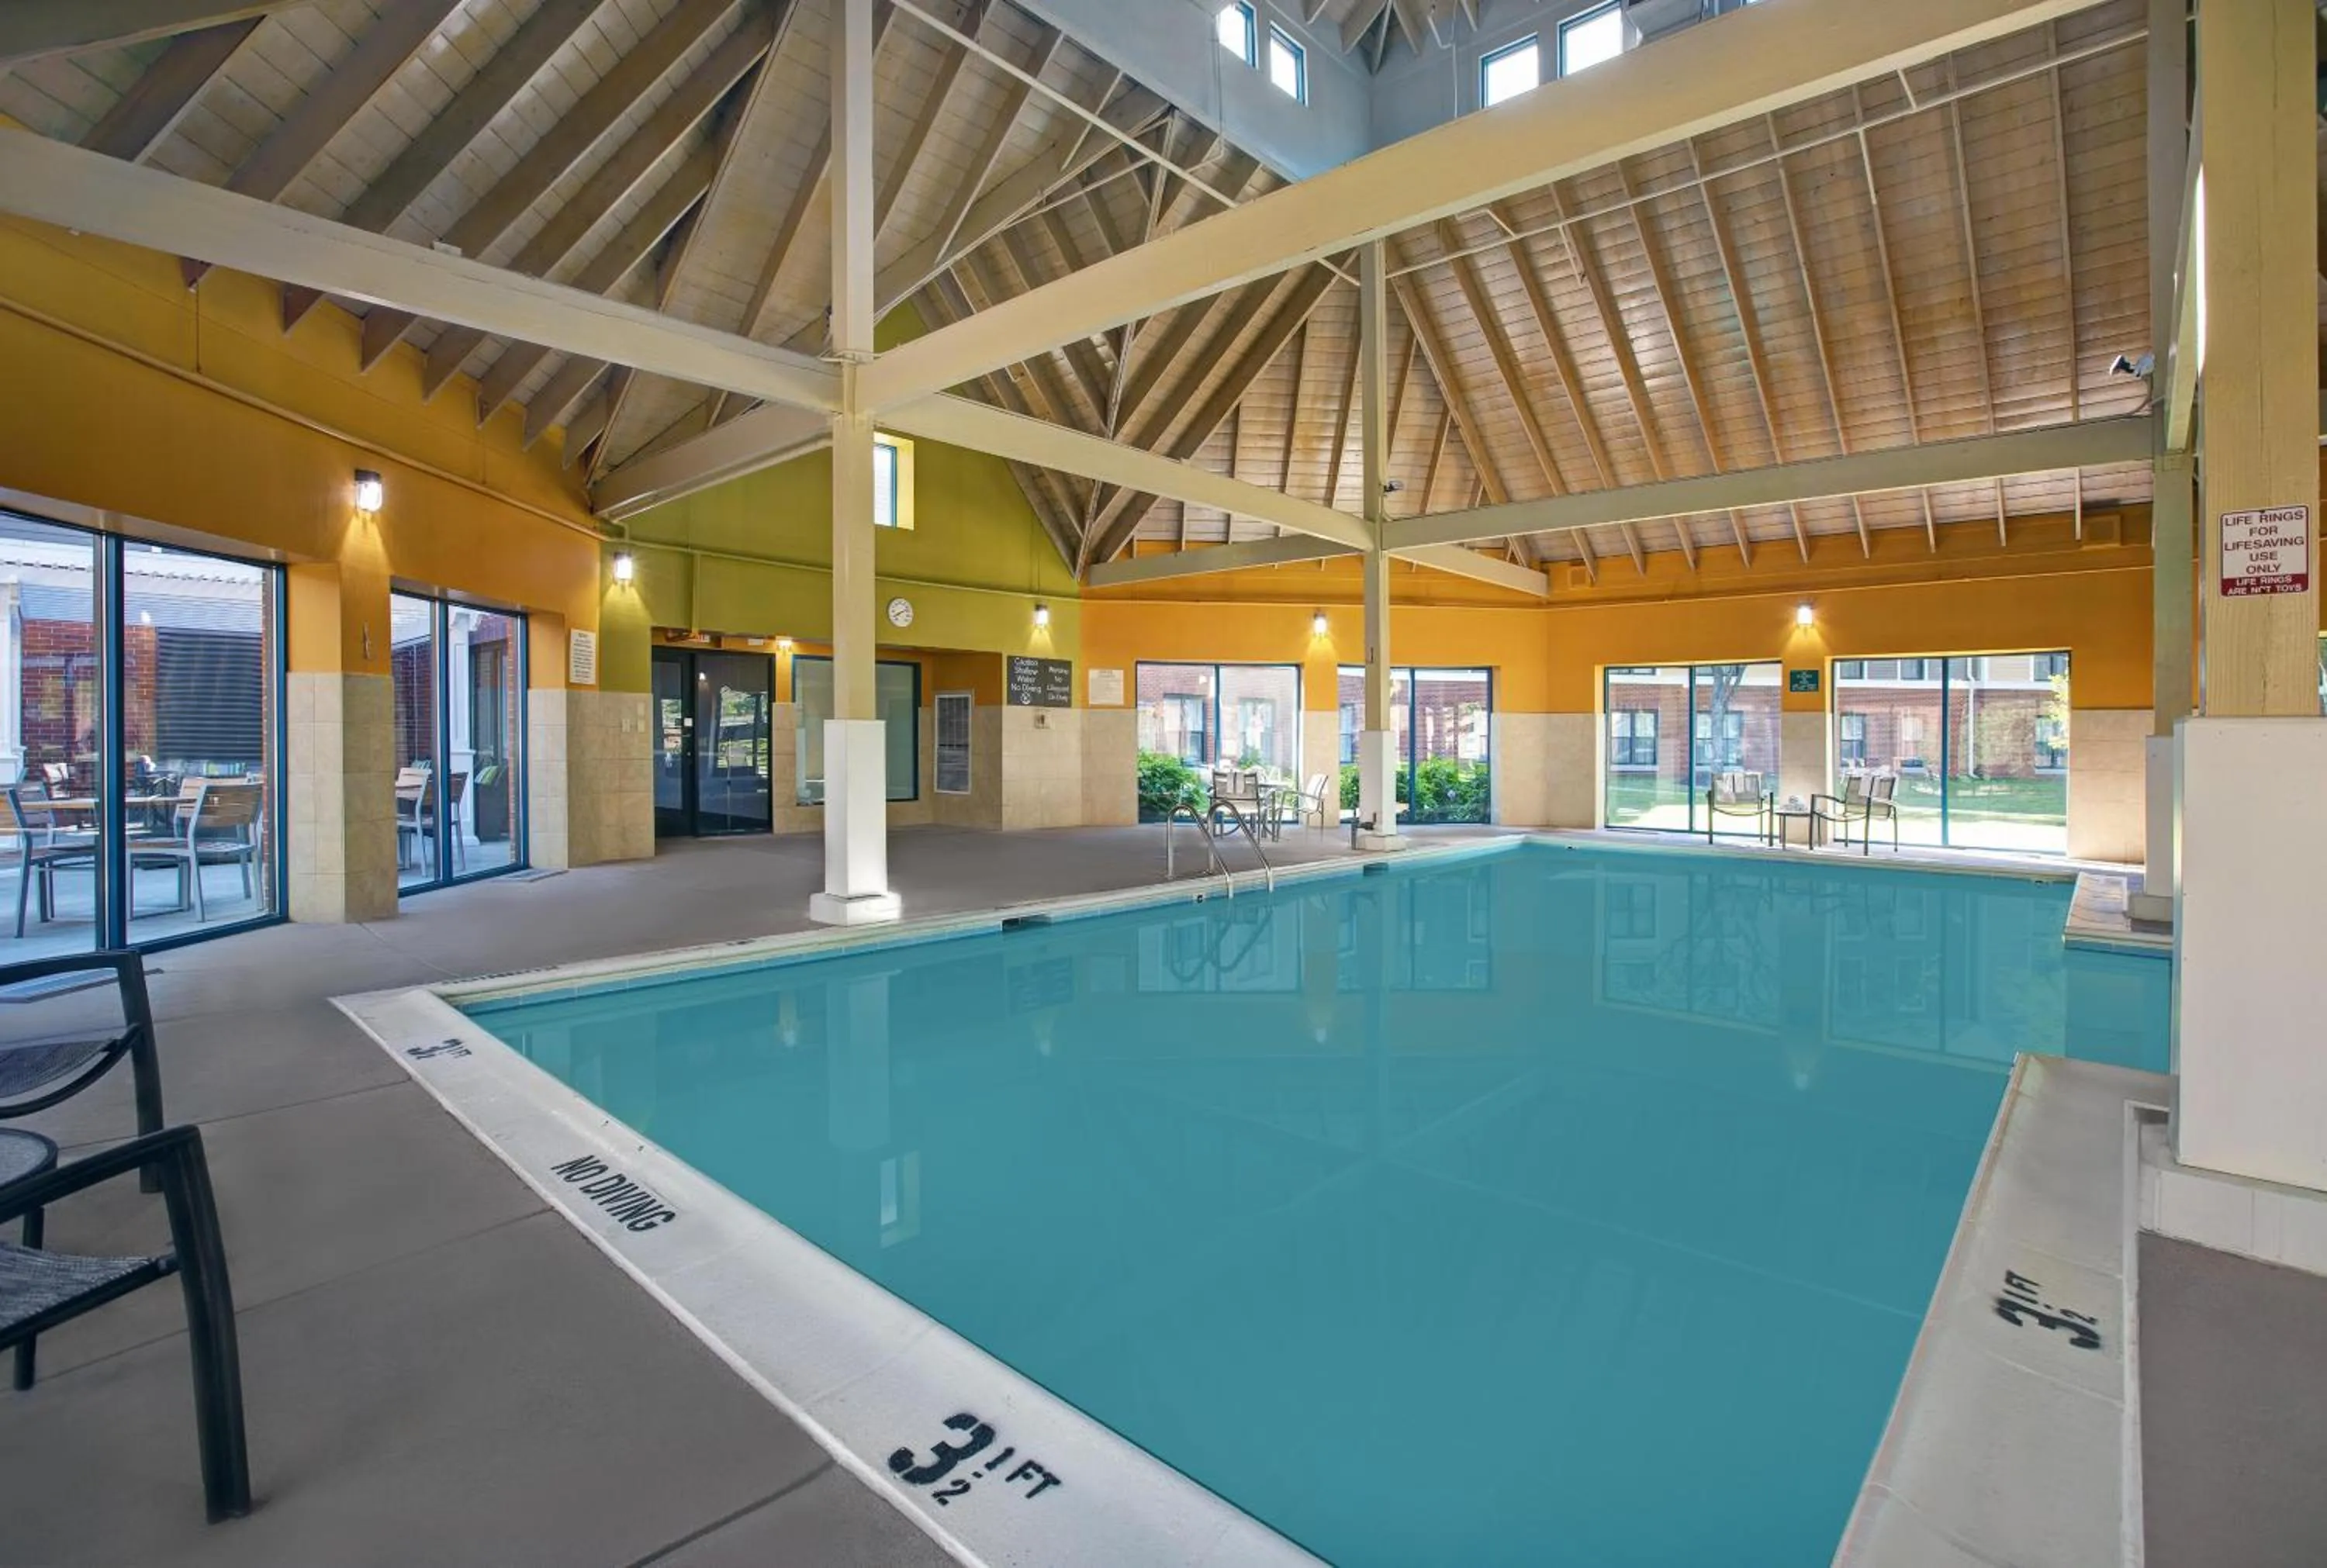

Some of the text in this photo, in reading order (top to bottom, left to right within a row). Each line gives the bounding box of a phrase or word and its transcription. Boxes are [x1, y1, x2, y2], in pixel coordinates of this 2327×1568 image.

[2225, 510, 2304, 527] LIFE RINGS
[2249, 526, 2278, 537] FOR
[2224, 536, 2305, 551] LIFESAVING
[2249, 551, 2278, 562] USE
[2246, 563, 2281, 575] ONLY
[2236, 575, 2293, 586] LIFE RINGS
[2227, 587, 2247, 596] ARE
[2277, 583, 2302, 592] TOYS
[550, 1154, 676, 1232] NO DIVING
[1004, 1459, 1063, 1501] FT
